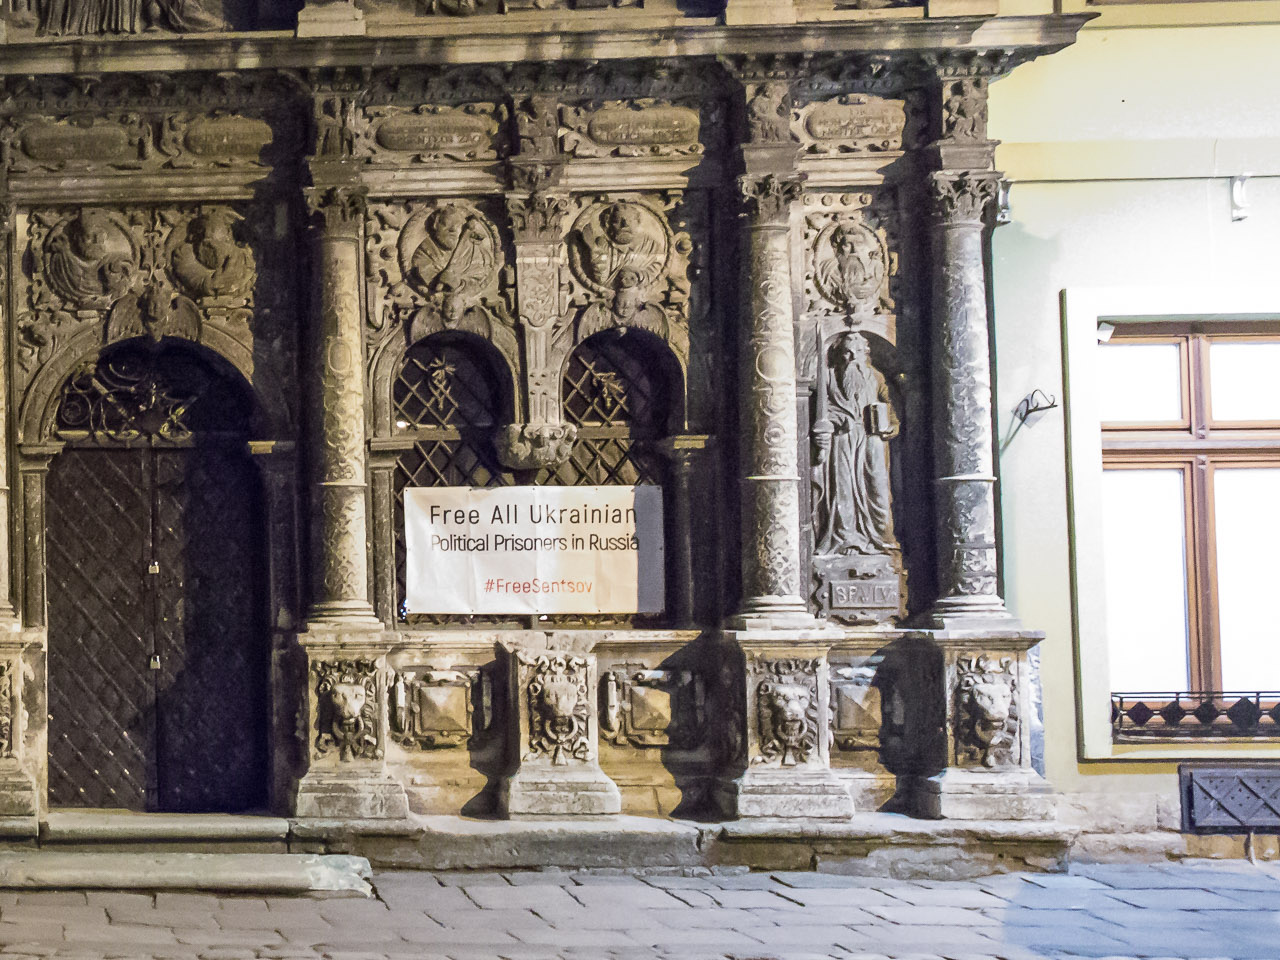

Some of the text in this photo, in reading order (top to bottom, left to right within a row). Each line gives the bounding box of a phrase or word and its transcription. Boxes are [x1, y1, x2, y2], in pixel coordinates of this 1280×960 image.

[430, 504, 637, 525] Free All Ukrainian
[431, 533, 640, 552] Political Prisoners in Russia
[484, 578, 593, 594] #FreeSentsov
